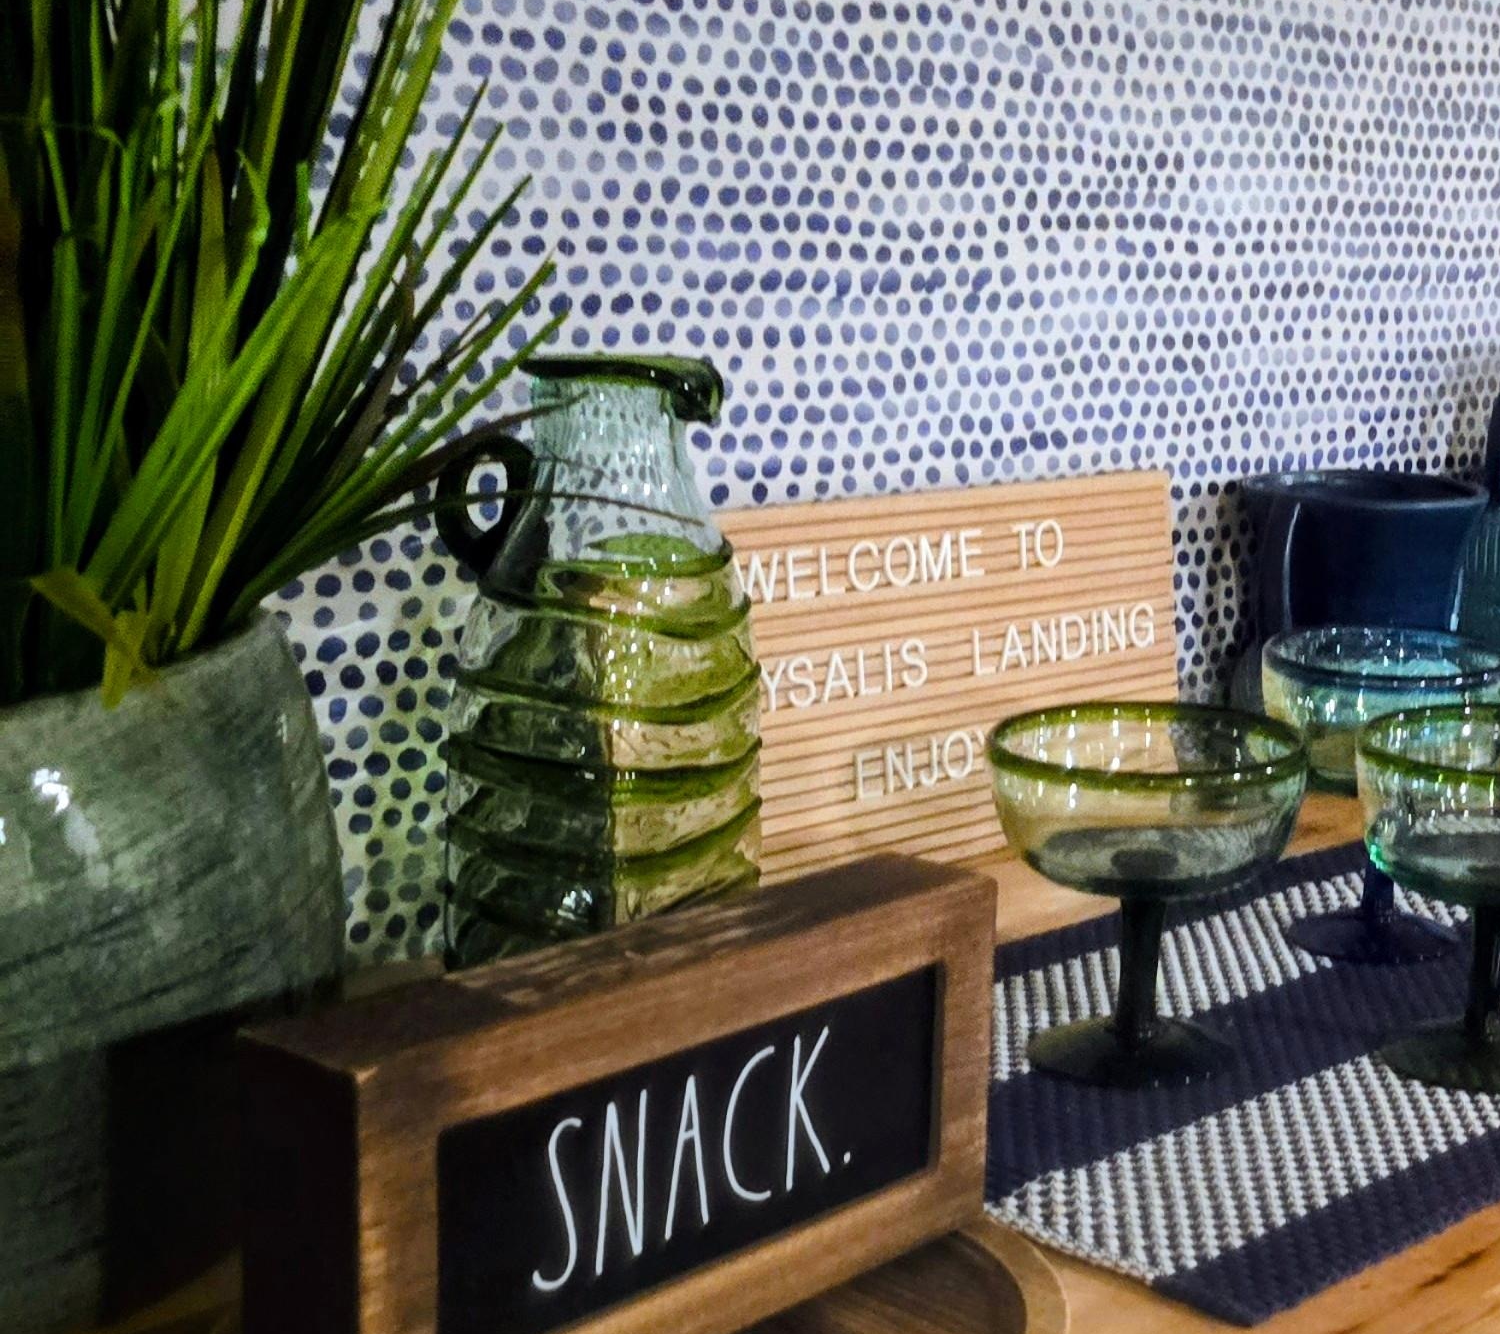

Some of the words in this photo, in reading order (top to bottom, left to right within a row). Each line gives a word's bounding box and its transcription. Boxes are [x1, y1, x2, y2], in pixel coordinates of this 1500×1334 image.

[732, 528, 985, 603] WELCOME
[1011, 518, 1064, 571] TO
[972, 602, 1155, 676] LANDING
[853, 726, 986, 802] ENJO
[532, 1025, 851, 1292] SNACK.
